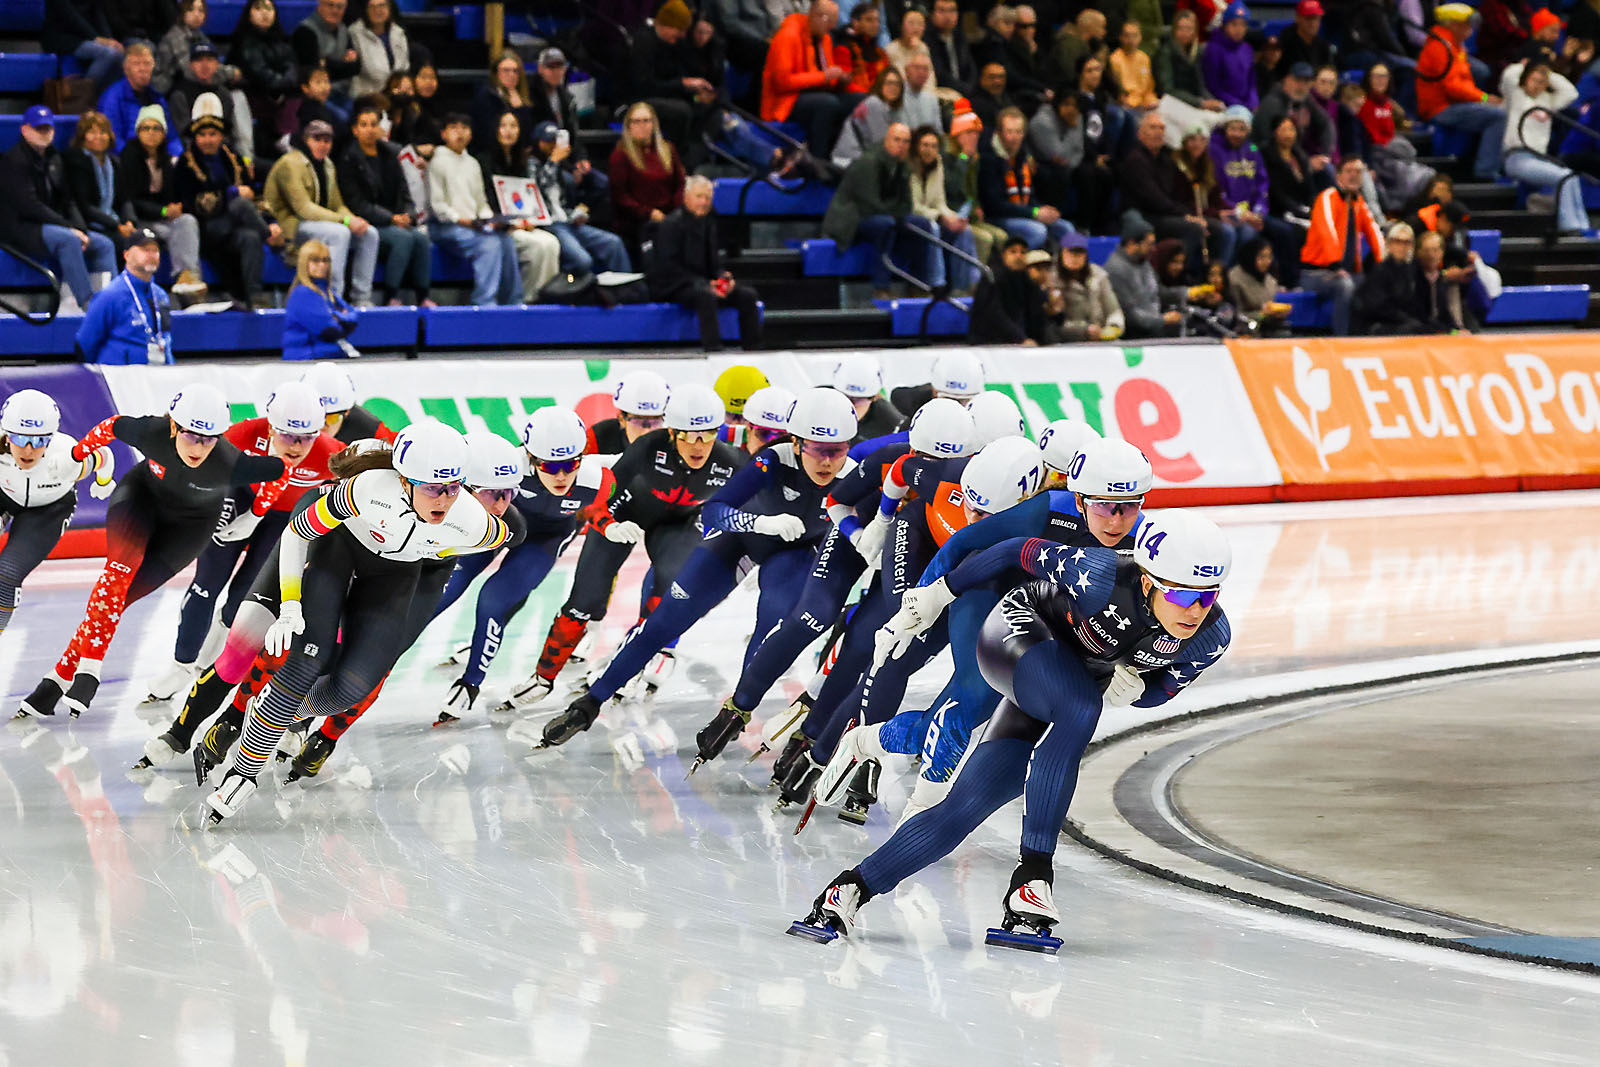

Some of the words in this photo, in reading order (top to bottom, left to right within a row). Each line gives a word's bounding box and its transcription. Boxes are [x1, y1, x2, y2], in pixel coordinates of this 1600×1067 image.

[1342, 353, 1600, 439] EuroPa
[1050, 518, 1078, 531] BIORACER
[1136, 520, 1168, 562] 14
[891, 519, 910, 595] staatsloterij
[800, 611, 826, 633] FILA
[1088, 616, 1119, 647] USANA
